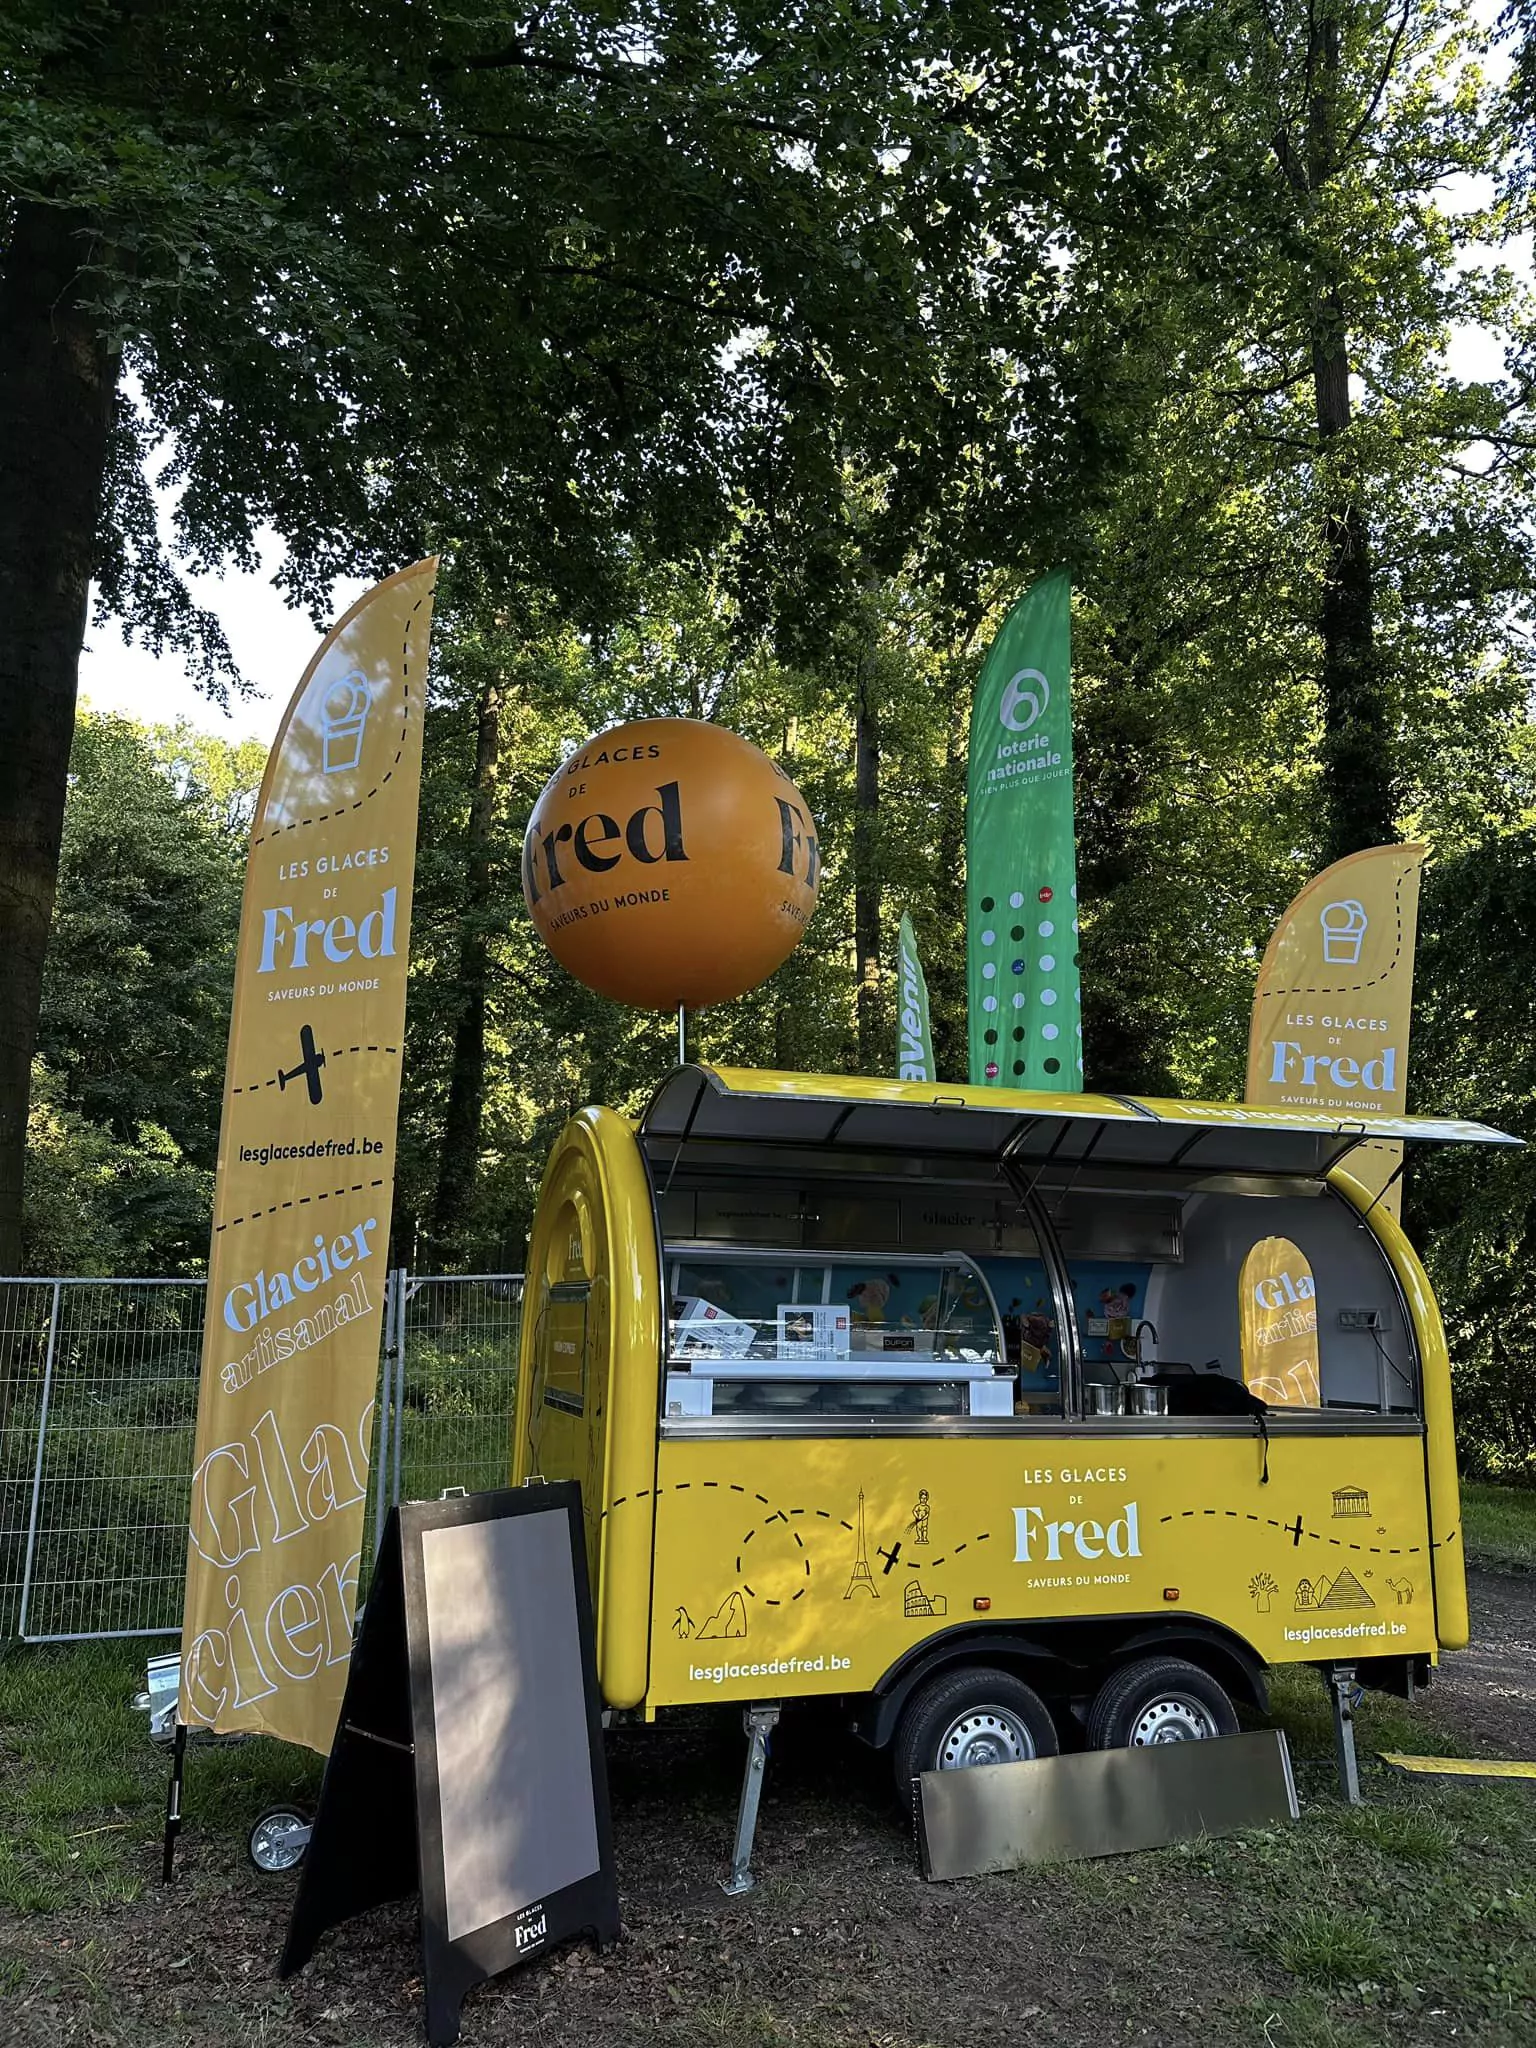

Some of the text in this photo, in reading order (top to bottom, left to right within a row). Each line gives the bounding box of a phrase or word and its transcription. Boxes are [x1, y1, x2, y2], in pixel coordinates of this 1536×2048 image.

[997, 733, 1049, 759] loterie
[567, 745, 660, 775] GLACES
[987, 750, 1061, 780] nationale
[569, 783, 586, 799] DE
[1000, 780, 1020, 791] PLUS
[1022, 774, 1040, 785] QUE
[1042, 768, 1071, 781] JOUER
[279, 847, 389, 880] LES GLACES
[323, 887, 338, 899] DE
[550, 889, 670, 932] SAVEURS DU MONDE
[256, 886, 397, 973] Fred
[268, 978, 380, 1002] SAVEURS DU MONDE
[1286, 1014, 1388, 1032] LES GLACES
[1328, 1036, 1342, 1045] DE
[1268, 1041, 1396, 1092] Fred
[1280, 1095, 1383, 1111] SAVEURS DU MONDE
[239, 1137, 384, 1166] lesglacesdefred.be
[223, 1217, 377, 1333] Glacier
[220, 1271, 373, 1394] artisanal
[1024, 1468, 1128, 1484] LES GLACES
[1069, 1496, 1083, 1505] DE
[1011, 1501, 1143, 1563] Fred
[1027, 1574, 1131, 1589] SAVEURS DU MONDE
[1284, 1621, 1407, 1645] lesglacesdefred.be
[688, 1654, 851, 1684] lesglacesdefred.be
[514, 1913, 548, 1948] Fred
